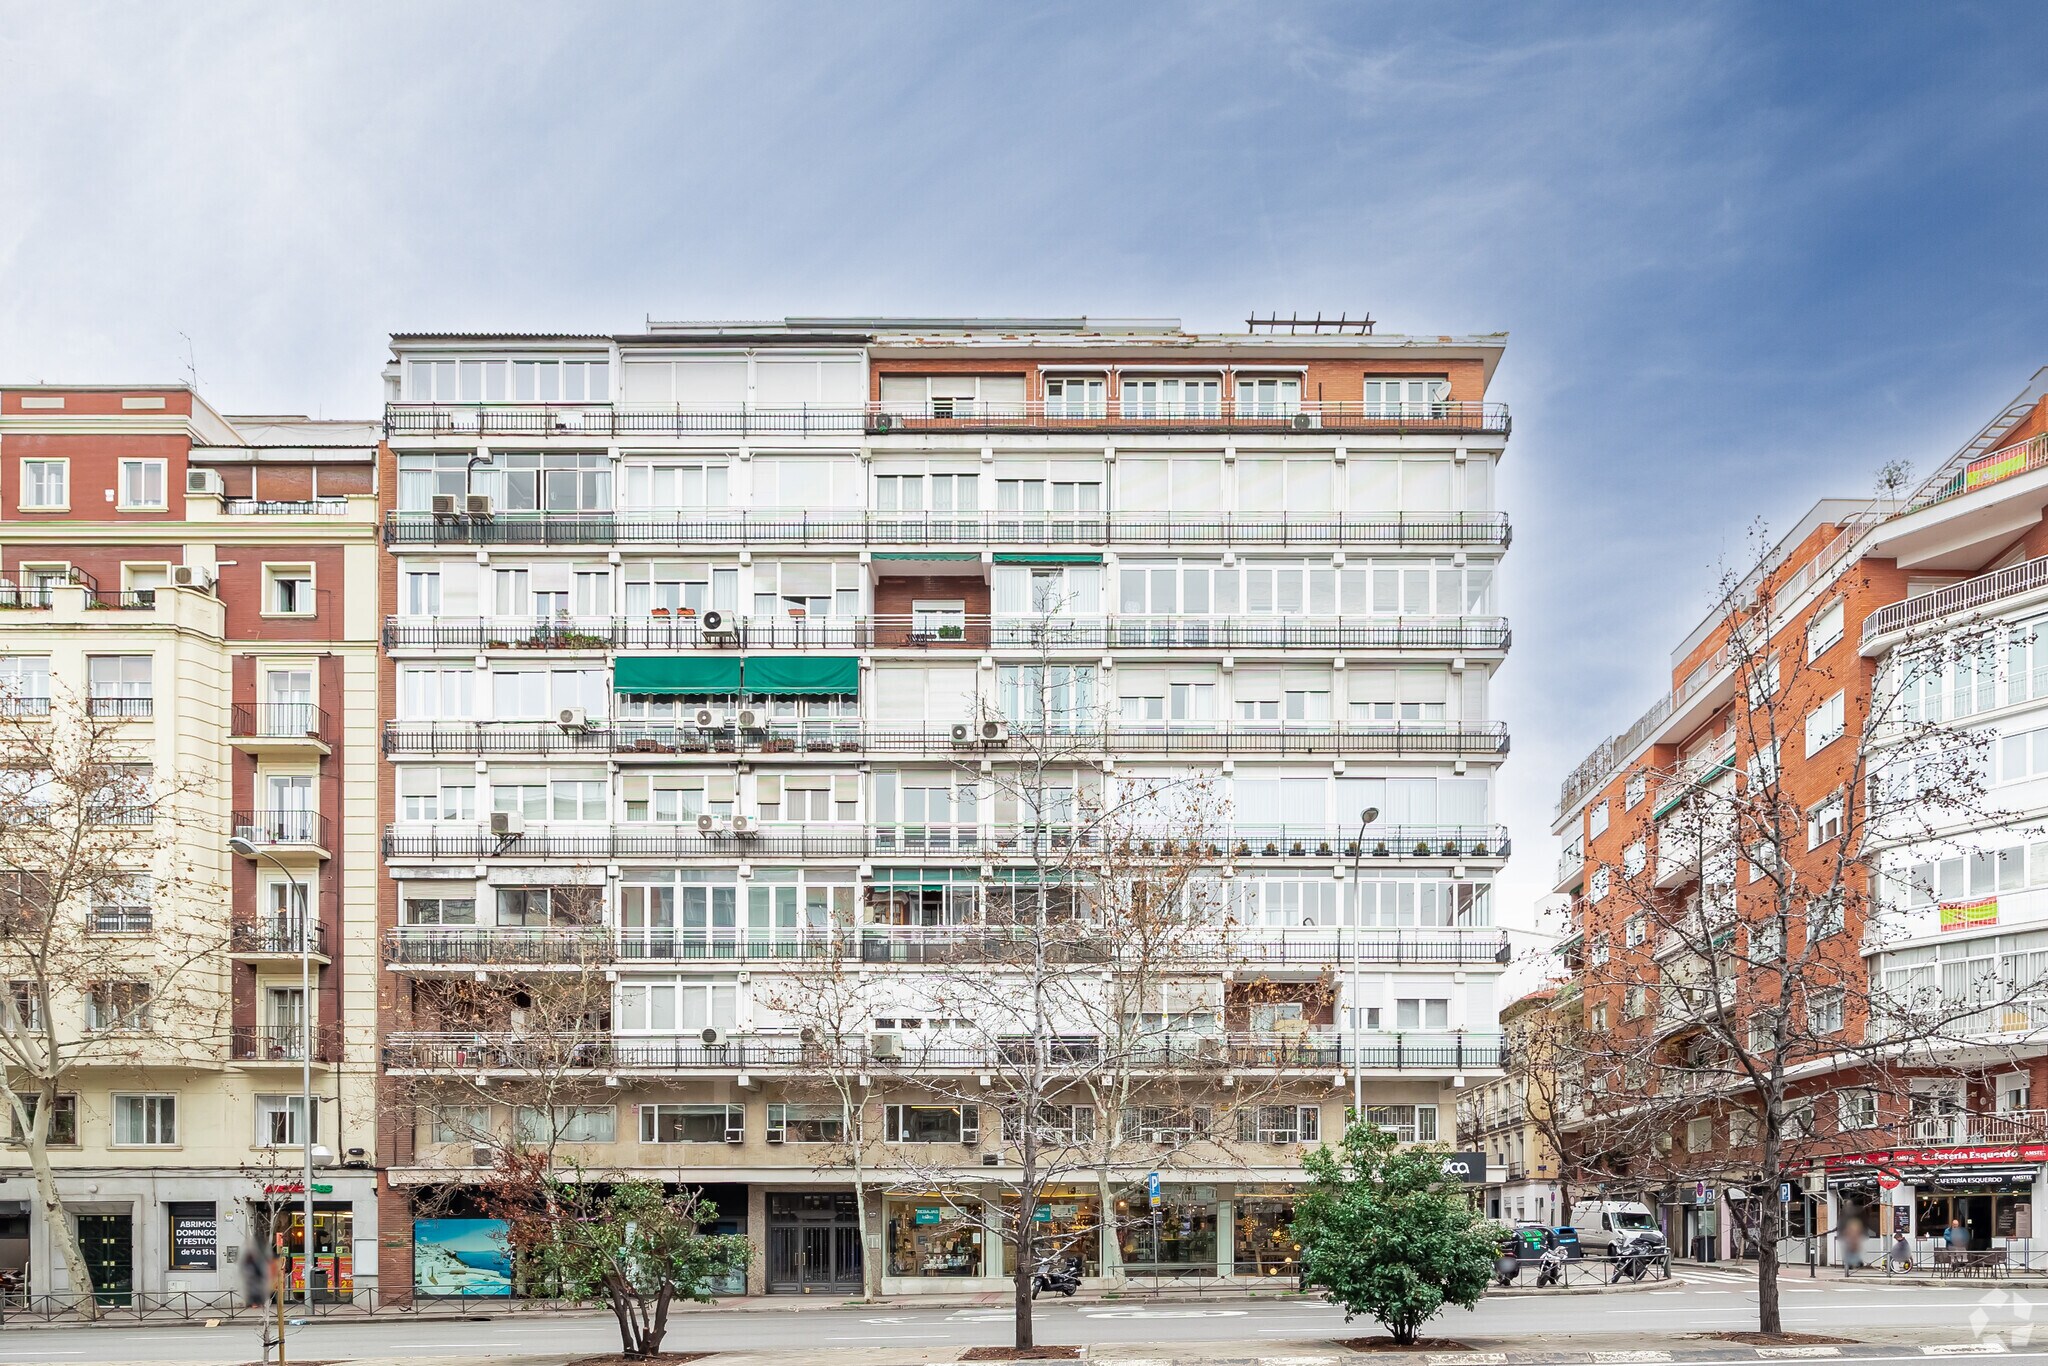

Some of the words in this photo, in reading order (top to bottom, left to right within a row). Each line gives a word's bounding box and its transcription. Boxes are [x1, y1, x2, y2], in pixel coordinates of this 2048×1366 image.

[1969, 1150, 2018, 1160] Esquerdo
[1152, 1176, 1157, 1193] P
[1782, 1186, 1787, 1199] P
[176, 1229, 217, 1237] DOMINGO
